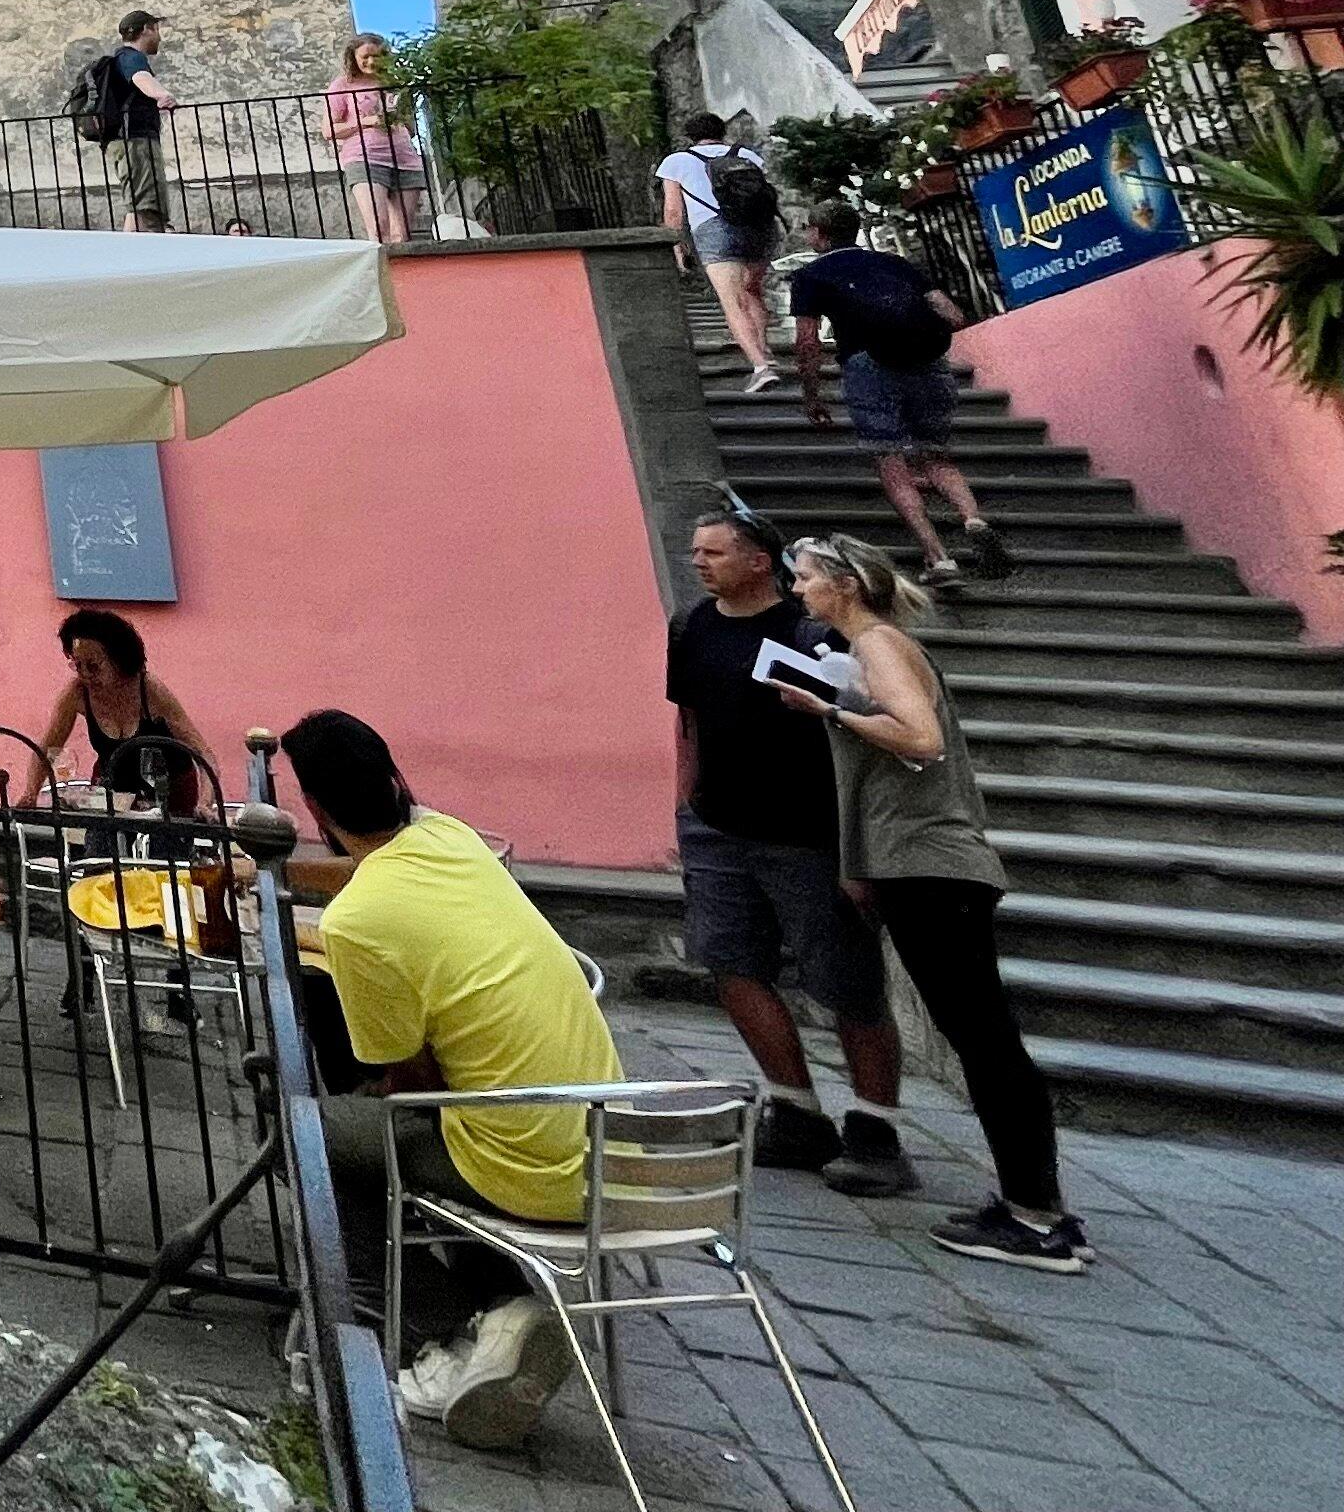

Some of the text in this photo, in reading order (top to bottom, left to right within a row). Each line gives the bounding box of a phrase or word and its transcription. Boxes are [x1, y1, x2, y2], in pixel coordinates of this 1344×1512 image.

[1028, 143, 1094, 187] LOCANDA
[1014, 175, 1109, 250] Lanterna
[1075, 235, 1124, 267] CAMERE
